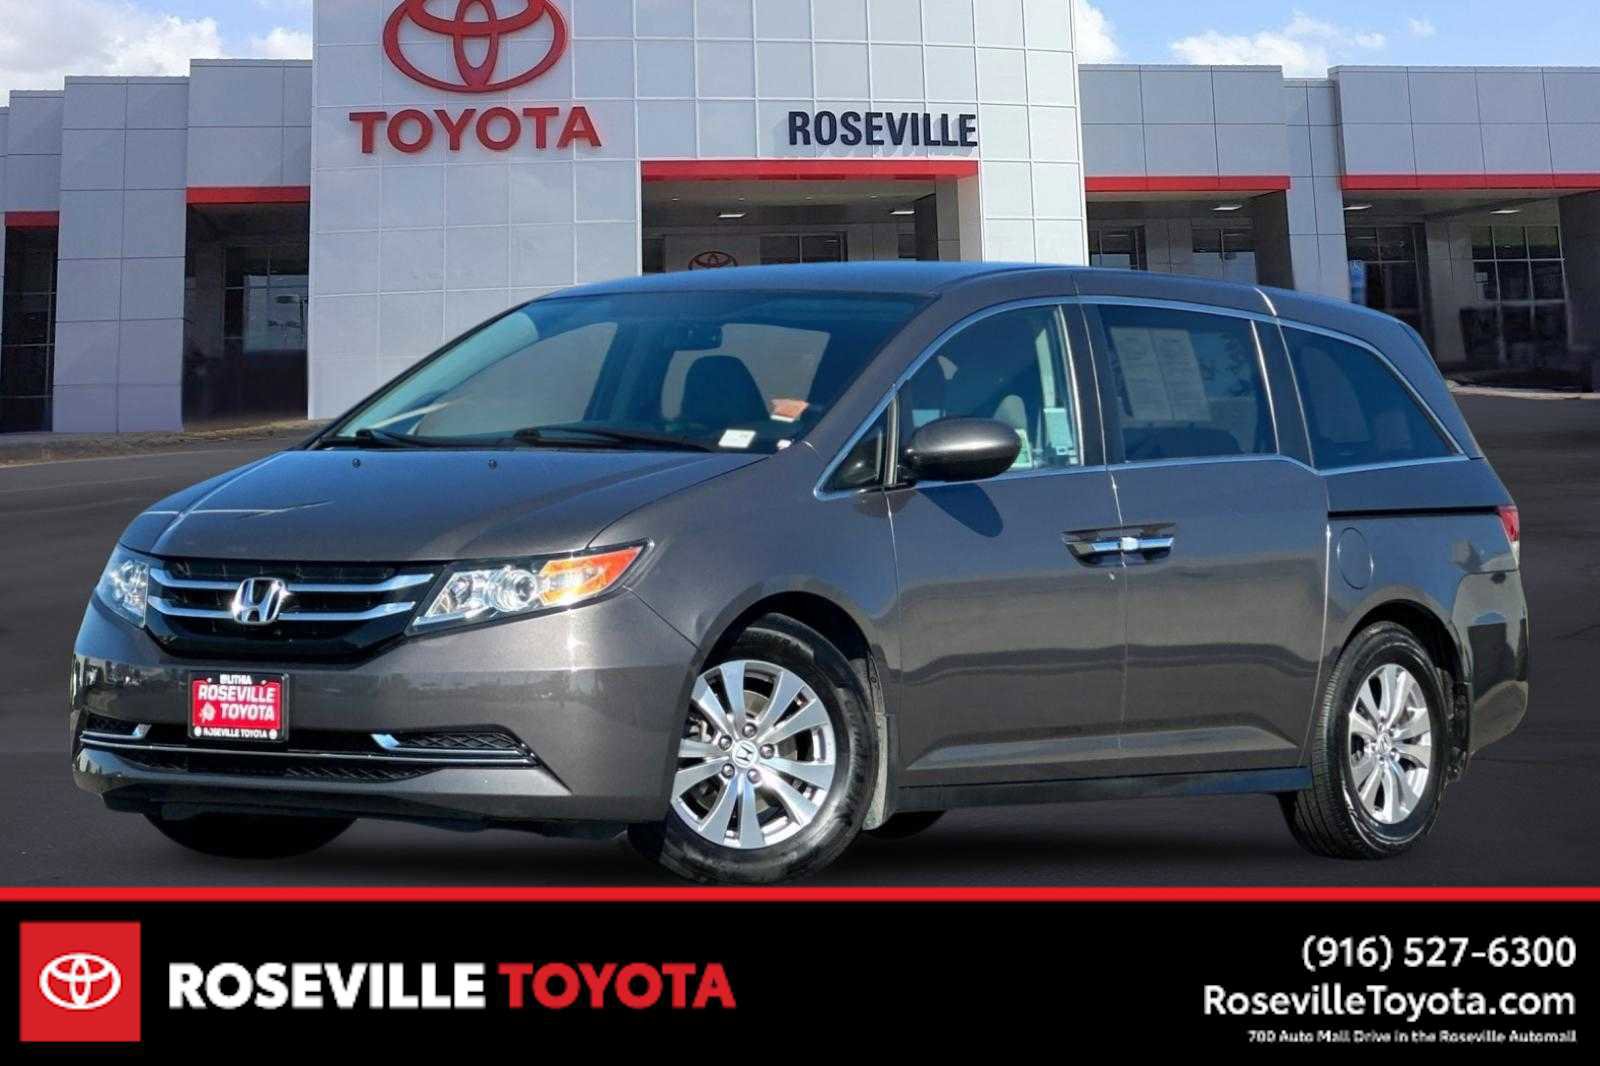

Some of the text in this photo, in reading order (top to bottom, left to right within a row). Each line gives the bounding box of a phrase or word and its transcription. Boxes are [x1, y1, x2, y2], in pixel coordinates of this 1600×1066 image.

[349, 106, 602, 154] TOYOTA
[788, 110, 978, 148] ROSEVILLE
[198, 684, 276, 703] ROSEVILLE
[220, 703, 275, 721] TOYOTA
[203, 727, 268, 739] ROSEVILLE TOYOTA
